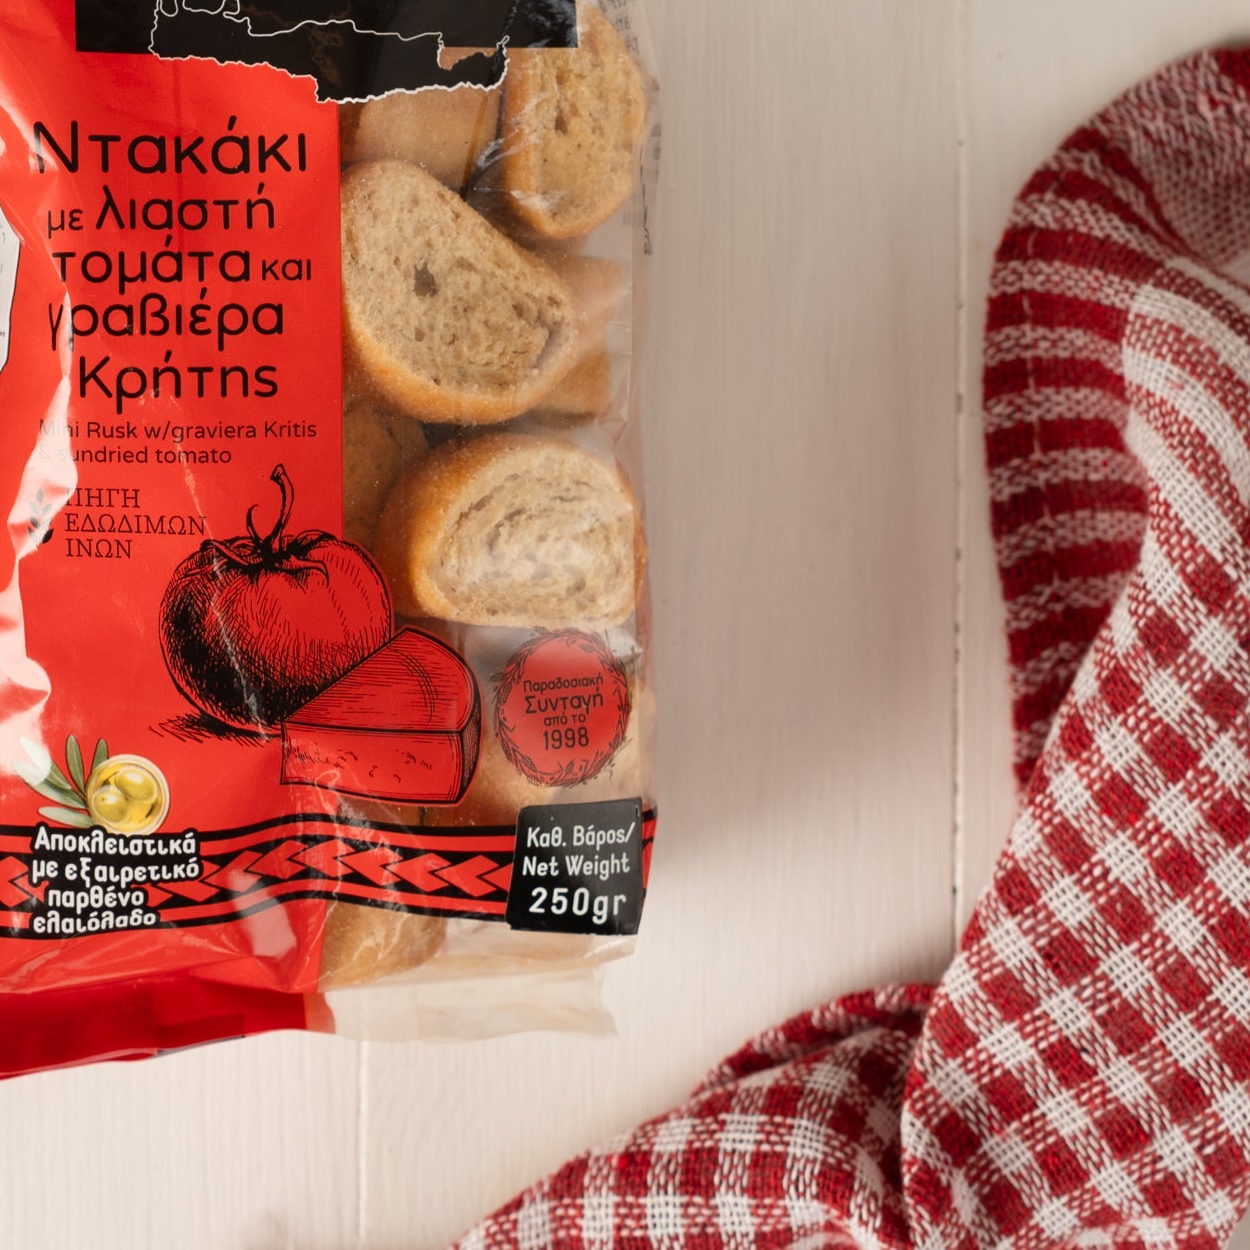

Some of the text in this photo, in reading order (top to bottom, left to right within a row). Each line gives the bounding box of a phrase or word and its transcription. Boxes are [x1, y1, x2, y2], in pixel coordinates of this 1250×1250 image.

[33, 114, 307, 175] Ντακάκι
[47, 182, 276, 239] με λιαστή
[51, 234, 312, 296] τομάτα και
[48, 286, 284, 352] γραβιέρα
[78, 349, 279, 415] Κρήτης
[86, 421, 138, 439] Rusk
[144, 420, 258, 444] w/graviera
[263, 420, 318, 438] Kritis
[58, 446, 149, 464] sundried
[155, 447, 233, 464] tomato
[65, 487, 141, 509] ΠΗΓΗ
[64, 512, 207, 536] ΕΔΩΔΙΜΩΝ
[65, 538, 133, 559] ΙΝΩΝ
[522, 672, 604, 696] Παραδοσιακή
[524, 687, 604, 715] Συνταγή
[543, 711, 587, 727] από το
[542, 727, 590, 751] 1998
[33, 825, 197, 855] Αποκλειστικά
[526, 826, 567, 848] Καθ.
[32, 859, 59, 883] με
[521, 851, 631, 881] Net Weight
[48, 885, 144, 915] παρθένο
[527, 886, 628, 925] 250gr
[33, 908, 157, 934] ελαιόλαδο
